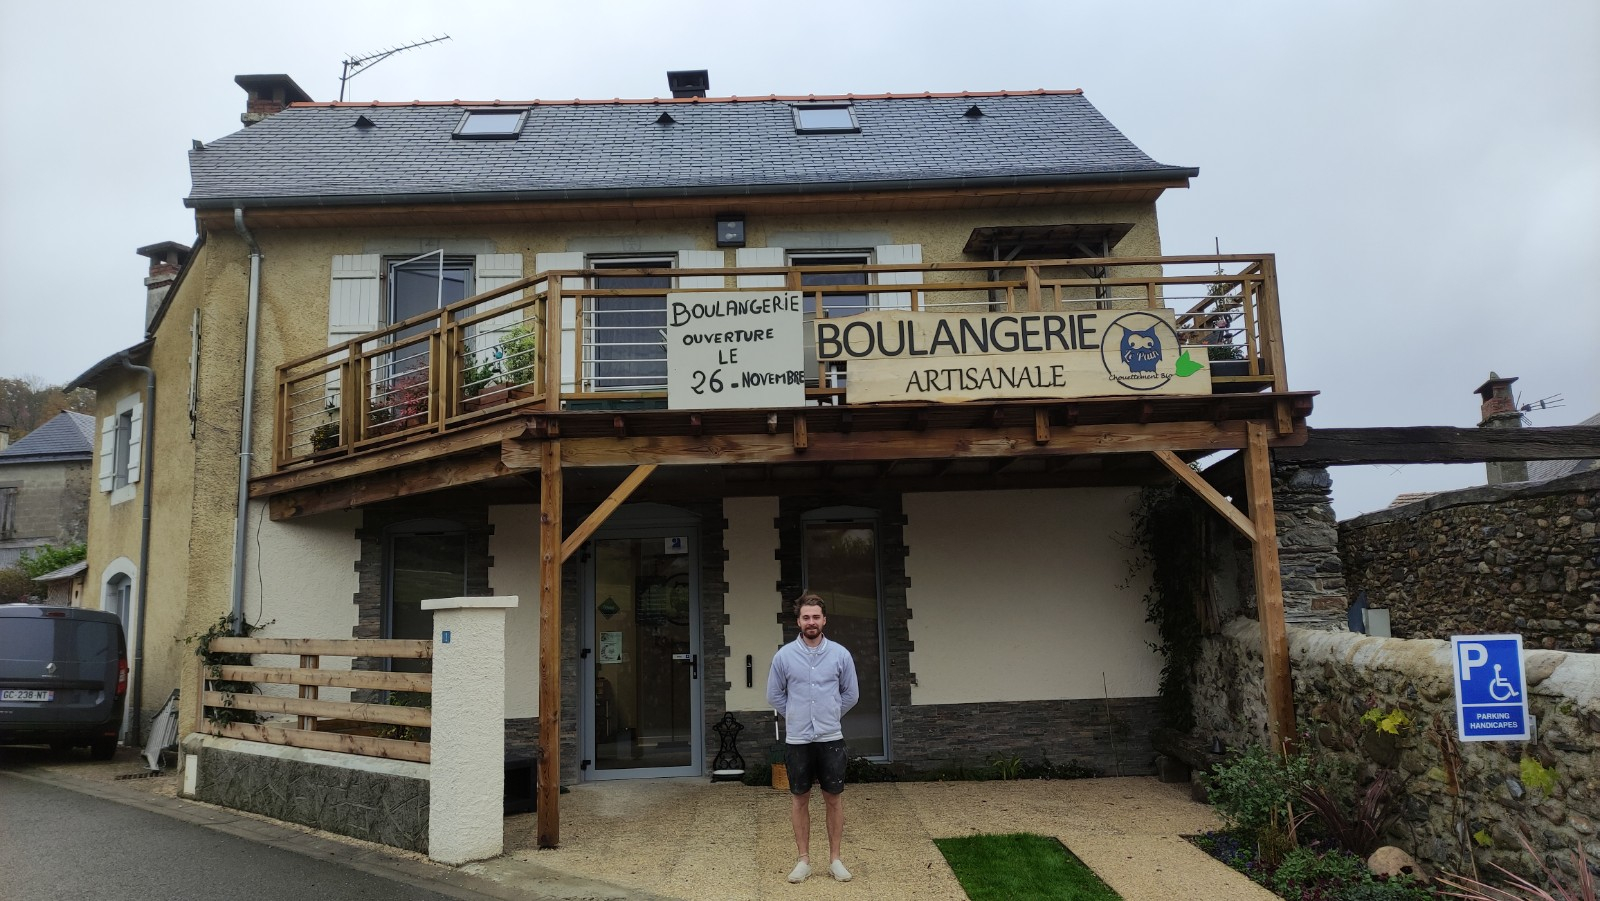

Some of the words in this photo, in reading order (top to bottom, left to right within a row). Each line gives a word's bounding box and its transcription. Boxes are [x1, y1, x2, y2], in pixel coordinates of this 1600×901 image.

[682, 328, 774, 345] OUVERTURE
[817, 313, 1100, 358] BOULANGERIE
[718, 348, 738, 365] LE
[905, 365, 1066, 393] ARTISANALE
[1109, 373, 1159, 381] Chouettement
[1460, 643, 1488, 680] P
[3, 690, 48, 699] GC-238-NT
[1476, 712, 1510, 720] PARKING
[1470, 721, 1518, 729] HANDICAPES
